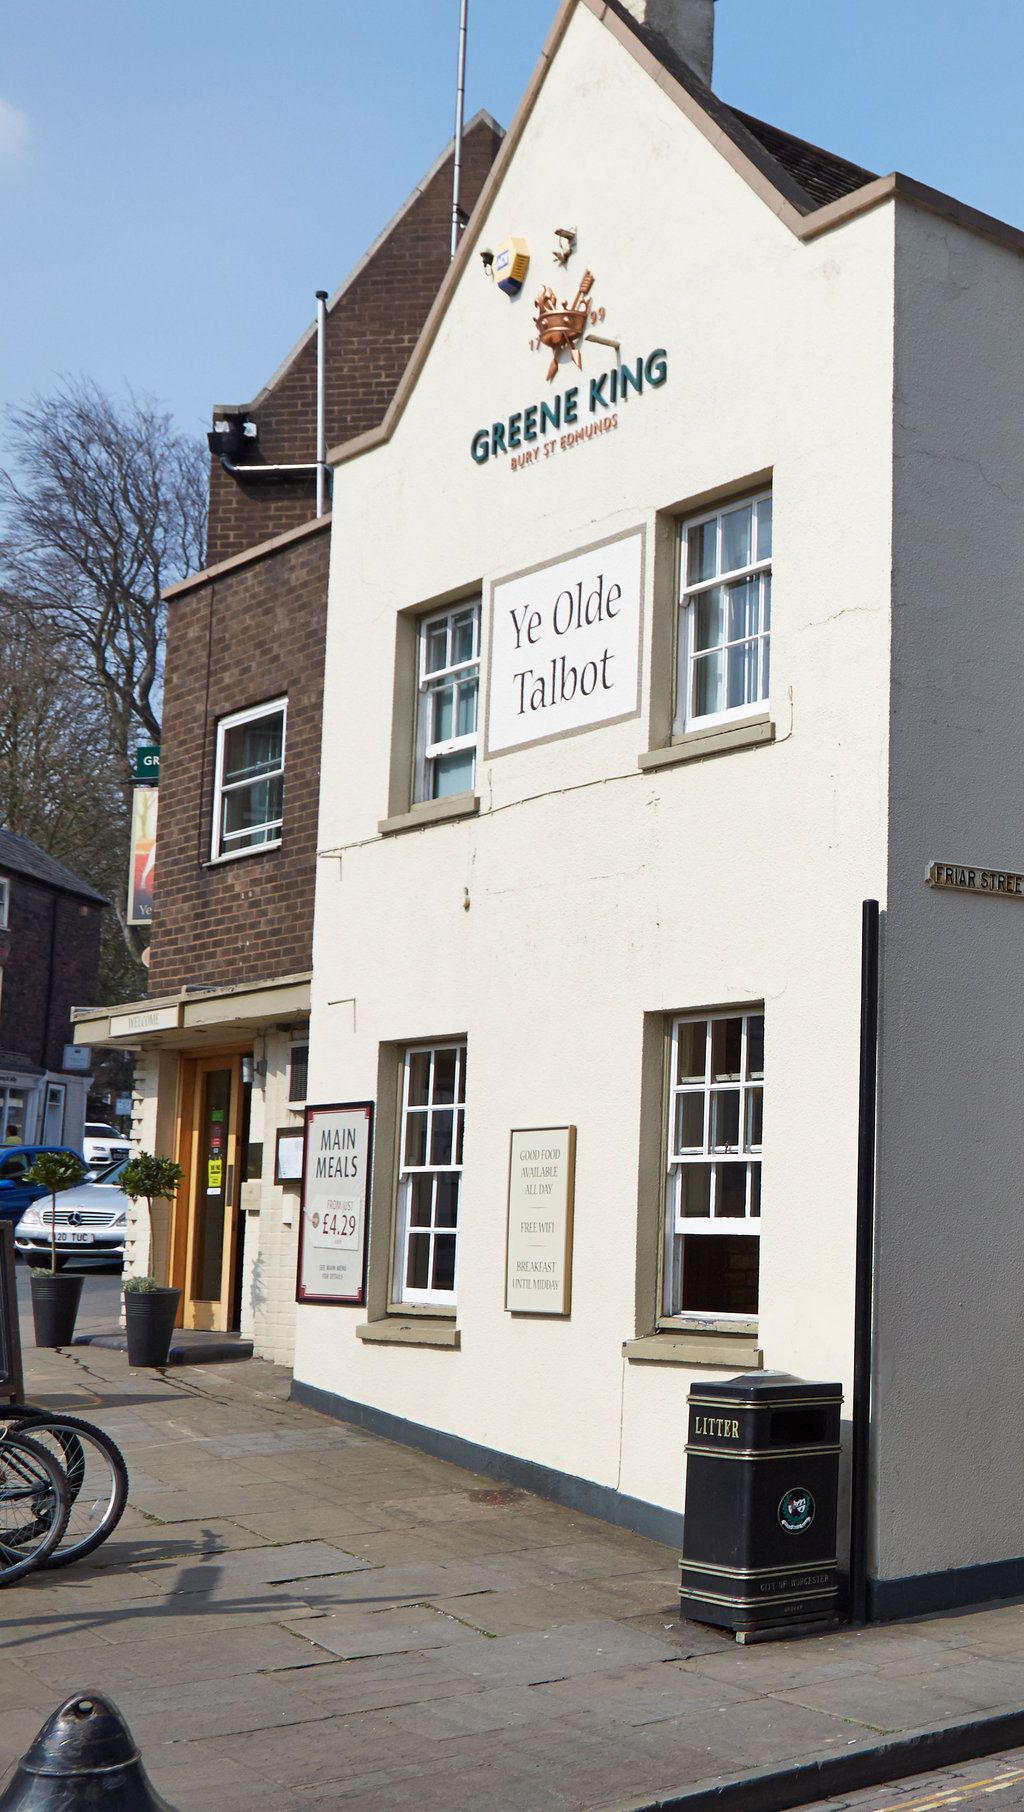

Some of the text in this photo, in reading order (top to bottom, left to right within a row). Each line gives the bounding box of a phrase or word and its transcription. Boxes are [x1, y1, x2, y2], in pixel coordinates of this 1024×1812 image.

[591, 307, 606, 326] 99
[471, 348, 668, 464] GREENE KING
[511, 413, 619, 471] BURY ST EDMUNDS
[509, 574, 622, 649] Ye Olde
[513, 648, 615, 715] Talbot
[936, 866, 976, 888] FRIAR
[128, 1013, 160, 1029] WELCOME
[320, 1128, 356, 1151] MAIN
[520, 1149, 561, 1161] GOOD FOOD
[316, 1155, 358, 1178] MEALS
[520, 1166, 559, 1178] AVAILABLE
[524, 1183, 554, 1195] ALL DAY
[327, 1199, 354, 1212] FROM JUST
[322, 1213, 356, 1236] £4.29
[520, 1221, 555, 1233] FREE WIFI
[72, 1232, 88, 1242] TUC
[516, 1260, 557, 1273] BREAKFAST
[512, 1278, 560, 1291] UNTIL MIDDAY
[695, 1416, 740, 1439] LITTER
